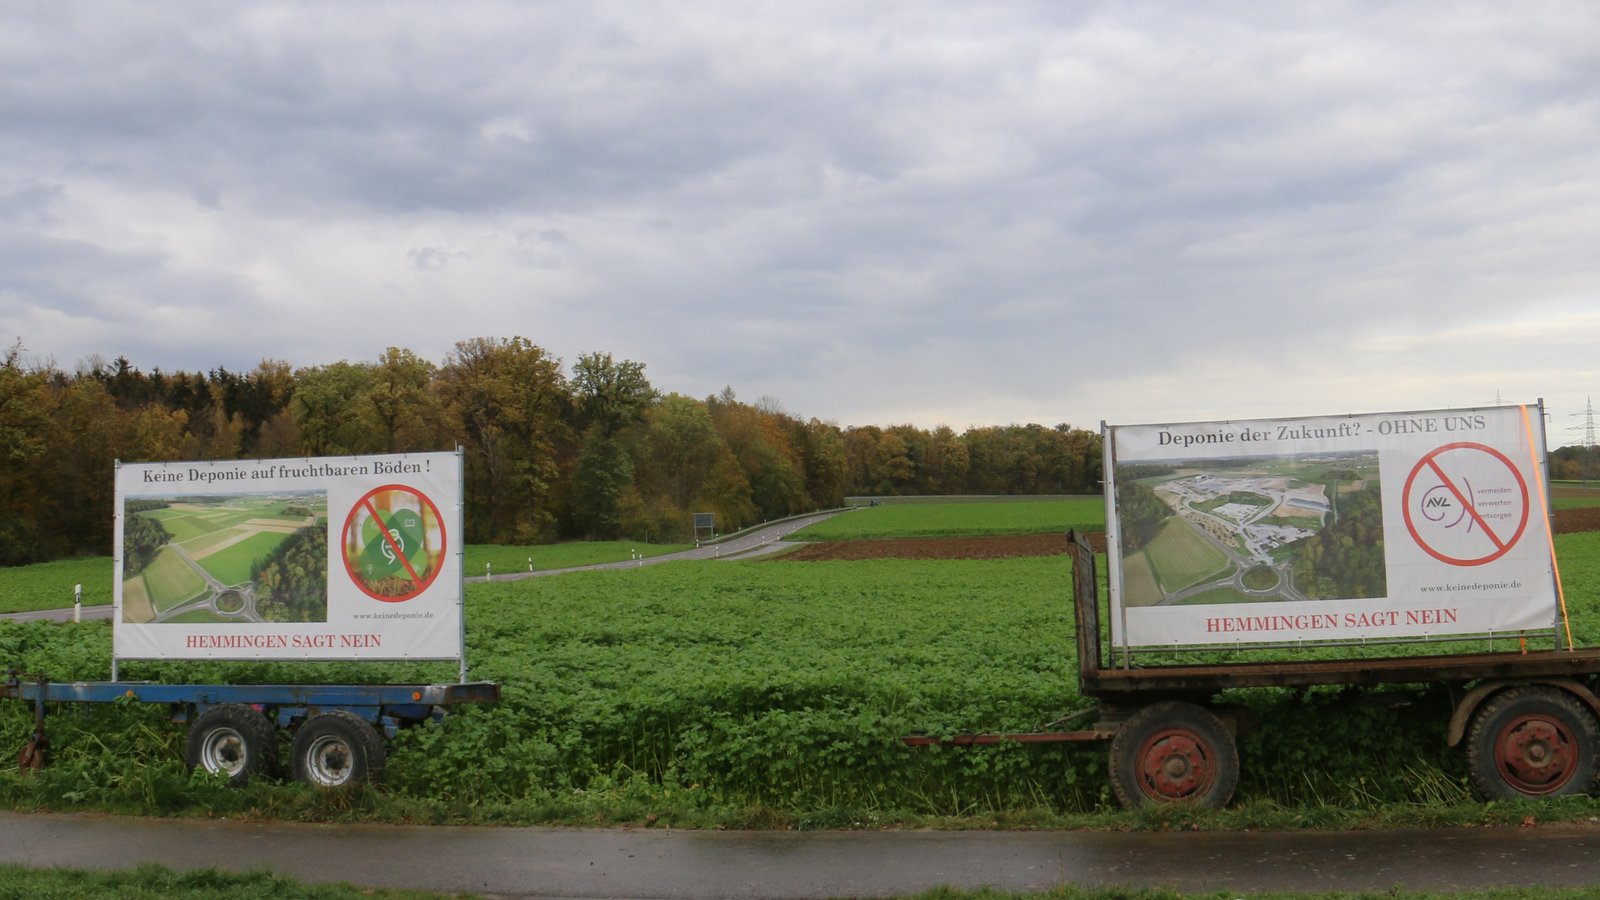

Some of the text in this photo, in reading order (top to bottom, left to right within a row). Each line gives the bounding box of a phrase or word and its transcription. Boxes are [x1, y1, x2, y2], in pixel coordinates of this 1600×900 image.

[1158, 429, 1234, 448] Deponie
[1240, 427, 1271, 442] der
[1276, 422, 1361, 441] Zukunft?
[1378, 418, 1438, 436] OHNE
[1444, 415, 1486, 432] UNS
[143, 469, 184, 483] Keine
[188, 468, 247, 484] Deponie
[251, 466, 276, 479] auf
[279, 463, 368, 478] fruchtbaren
[373, 460, 421, 475] Böden
[1477, 487, 1512, 495] vermeiden
[1478, 499, 1512, 507] verwerten
[1420, 580, 1522, 592] www.keinedeponie.de
[353, 611, 434, 620] www.keinedeponie.de
[1206, 608, 1458, 633] HEMMINGEN SAGT NEIN
[186, 634, 382, 648] HEMMINGEN SAGT NEIN
